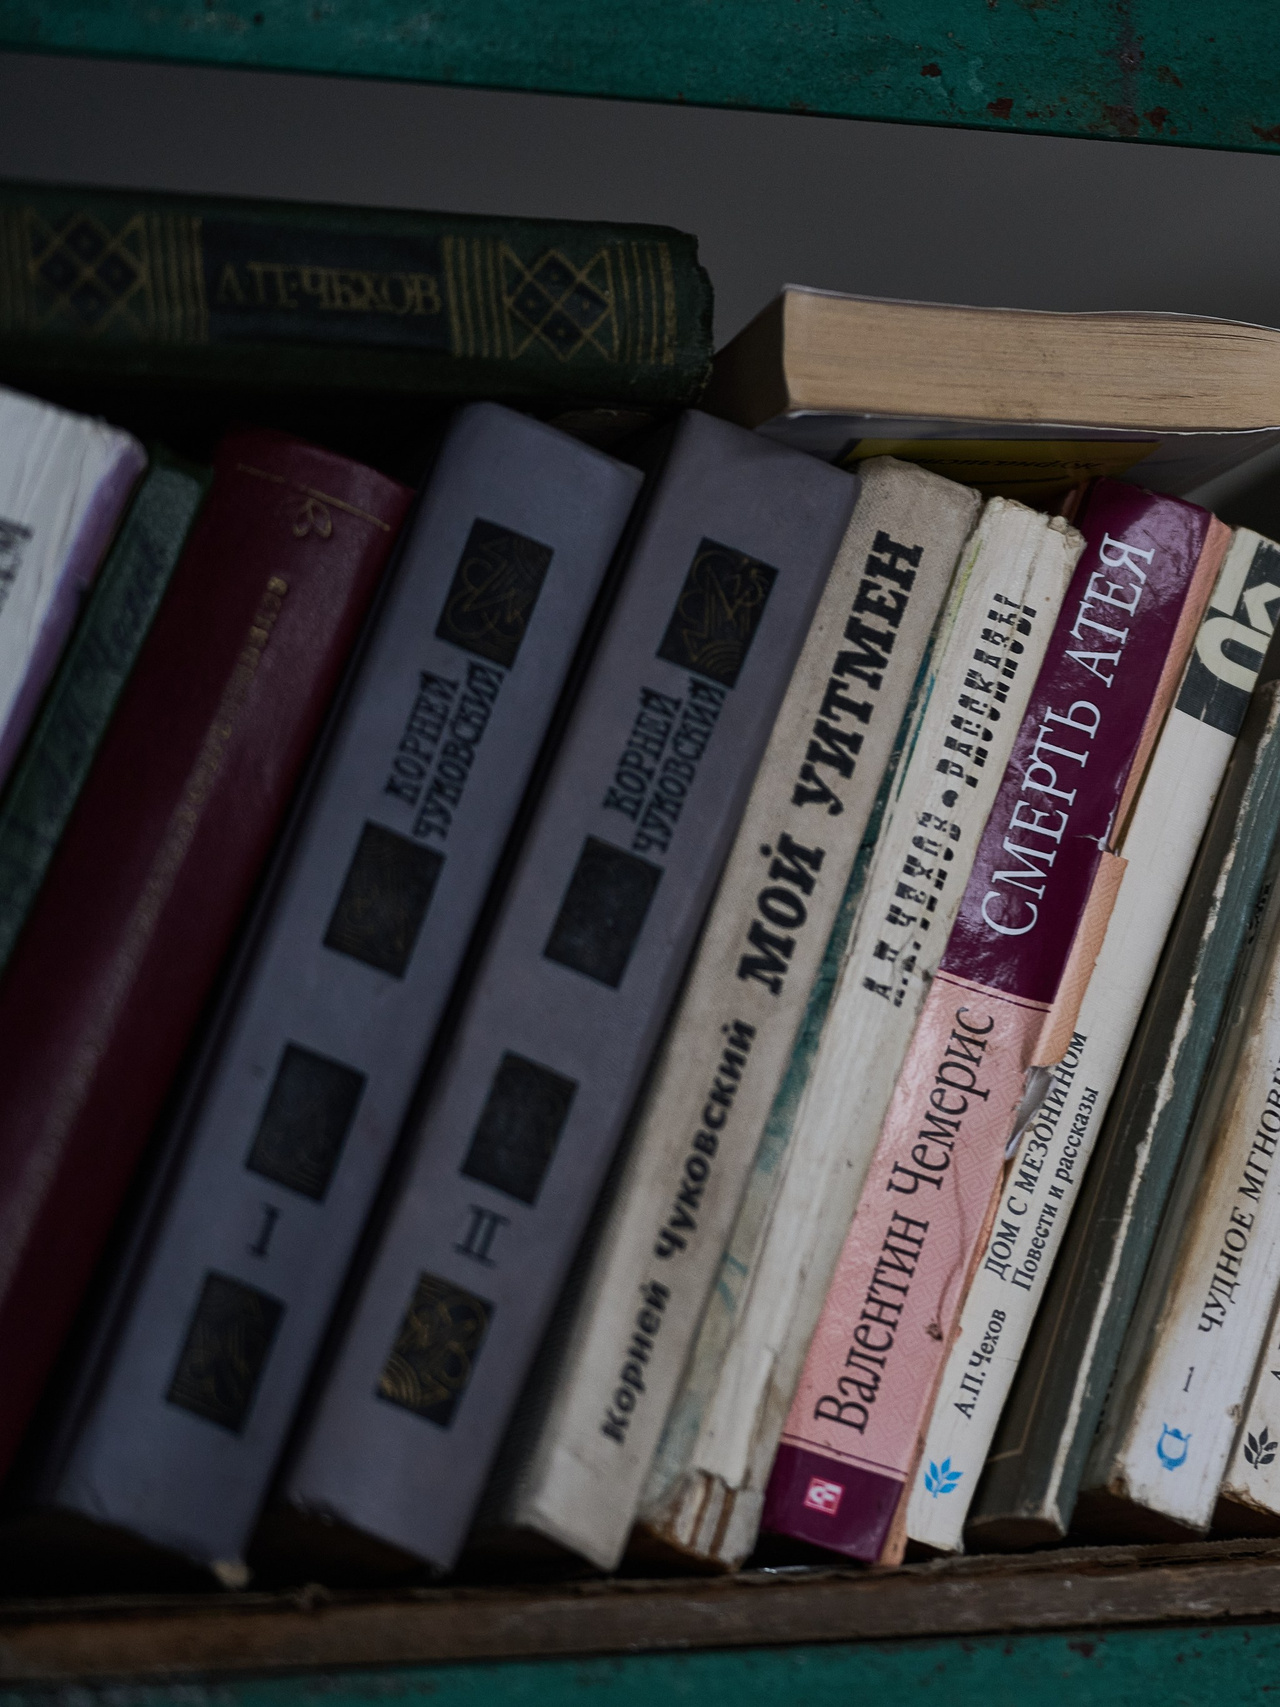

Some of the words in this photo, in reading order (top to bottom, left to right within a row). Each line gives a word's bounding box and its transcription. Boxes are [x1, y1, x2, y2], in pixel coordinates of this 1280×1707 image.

[383, 670, 460, 806] КОРНЕЙ
[412, 661, 504, 842] ЧУКОВСКИЙ
[604, 684, 681, 822] КОРНЕЙ
[632, 678, 728, 855] ЧУКОВСКИЙ
[738, 830, 825, 997] МОЙ
[791, 531, 924, 815] УИТМЕН
[935, 593, 1037, 787] РАССКАЗЫ
[981, 699, 1100, 936] СМЕРТЬ
[1065, 532, 1155, 688] АТЕЯ
[602, 1281, 673, 1446] Корней
[656, 1021, 757, 1263] Чуковский
[815, 1211, 929, 1435] Валентин
[888, 1007, 995, 1199] Чемерис
[984, 1222, 1025, 1281] ДОМ
[1011, 1196, 1028, 1214] С
[1025, 1031, 1088, 1195] МЕЗОНИНОМ
[1010, 1204, 1054, 1292] Повести
[1048, 1185, 1064, 1201] и
[1058, 1087, 1100, 1182] рассказы
[1200, 1211, 1254, 1334] ЧУДНОЕ
